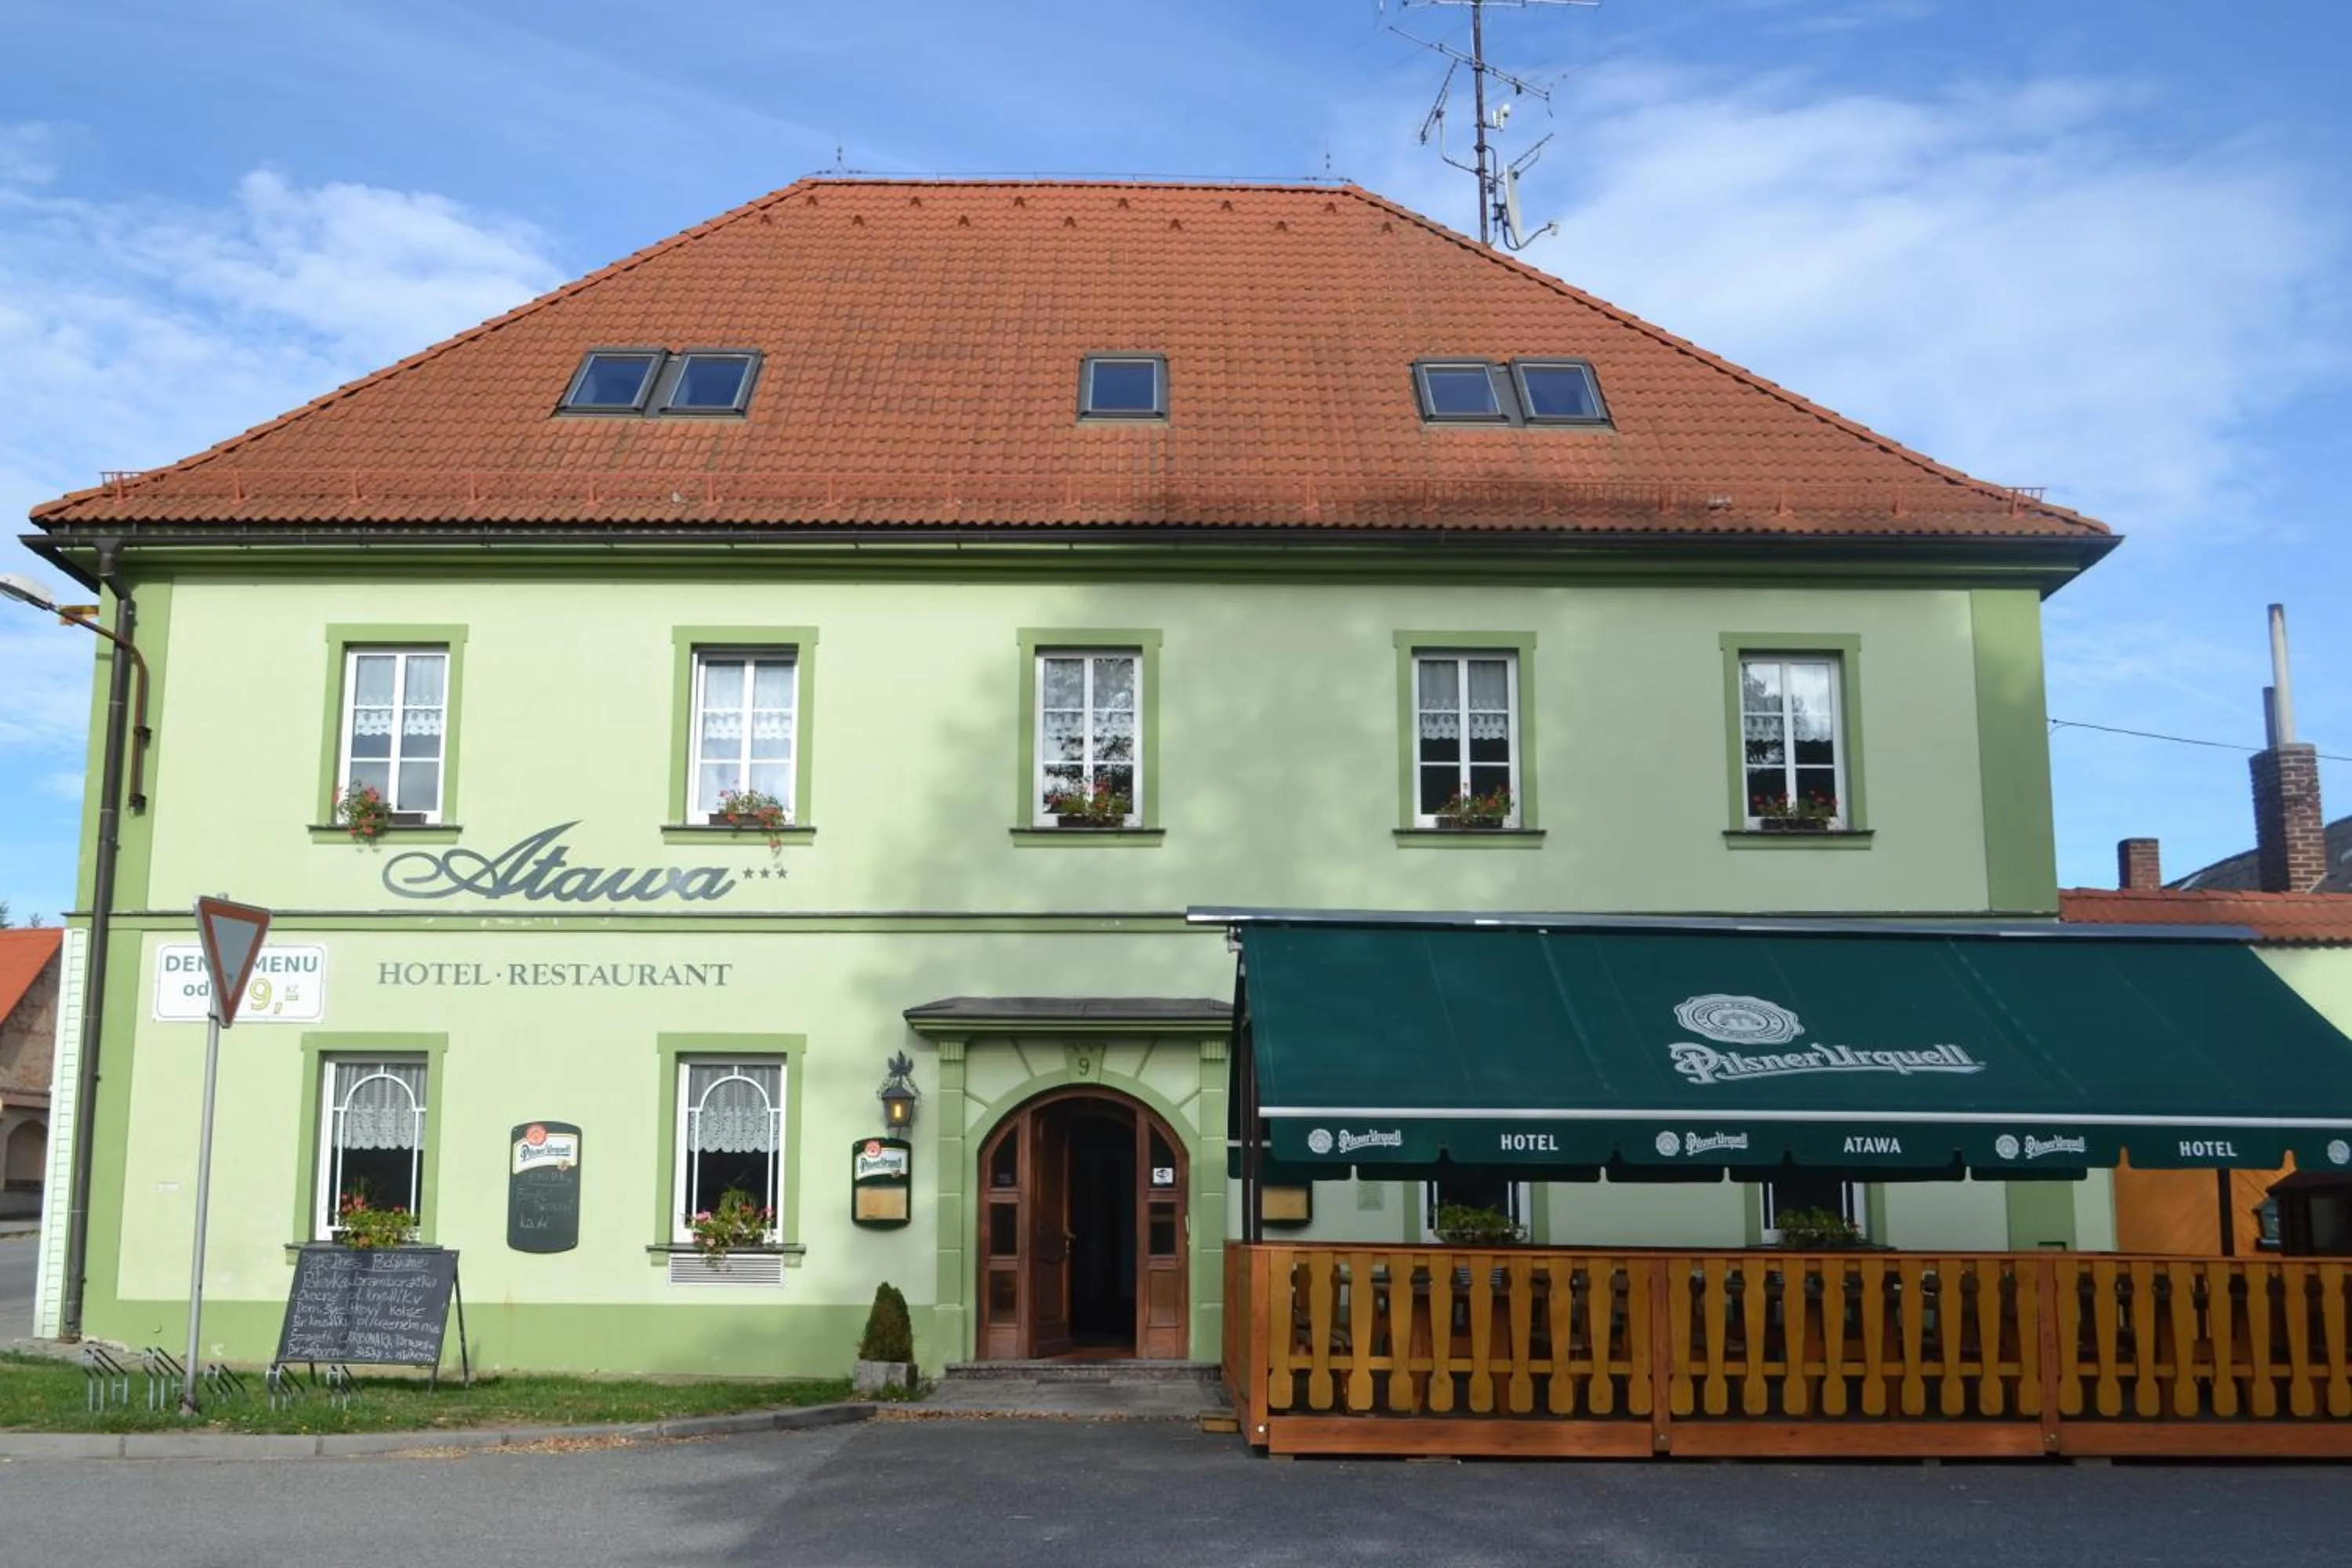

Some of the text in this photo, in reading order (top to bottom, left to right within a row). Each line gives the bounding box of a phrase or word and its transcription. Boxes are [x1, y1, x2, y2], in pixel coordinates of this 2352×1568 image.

[383, 819, 736, 902] Atawa
[377, 963, 732, 987] HOTEL RESTAURANT
[183, 982, 209, 996] od
[1078, 1058, 1090, 1076] 9
[1668, 1042, 1987, 1084] Pilsner Urquell
[1338, 1129, 1370, 1153] Pilsner
[1501, 1134, 1559, 1151] HOTEL
[1843, 1136, 1902, 1154] ATAWA
[2180, 1141, 2238, 1157] HOTEL
